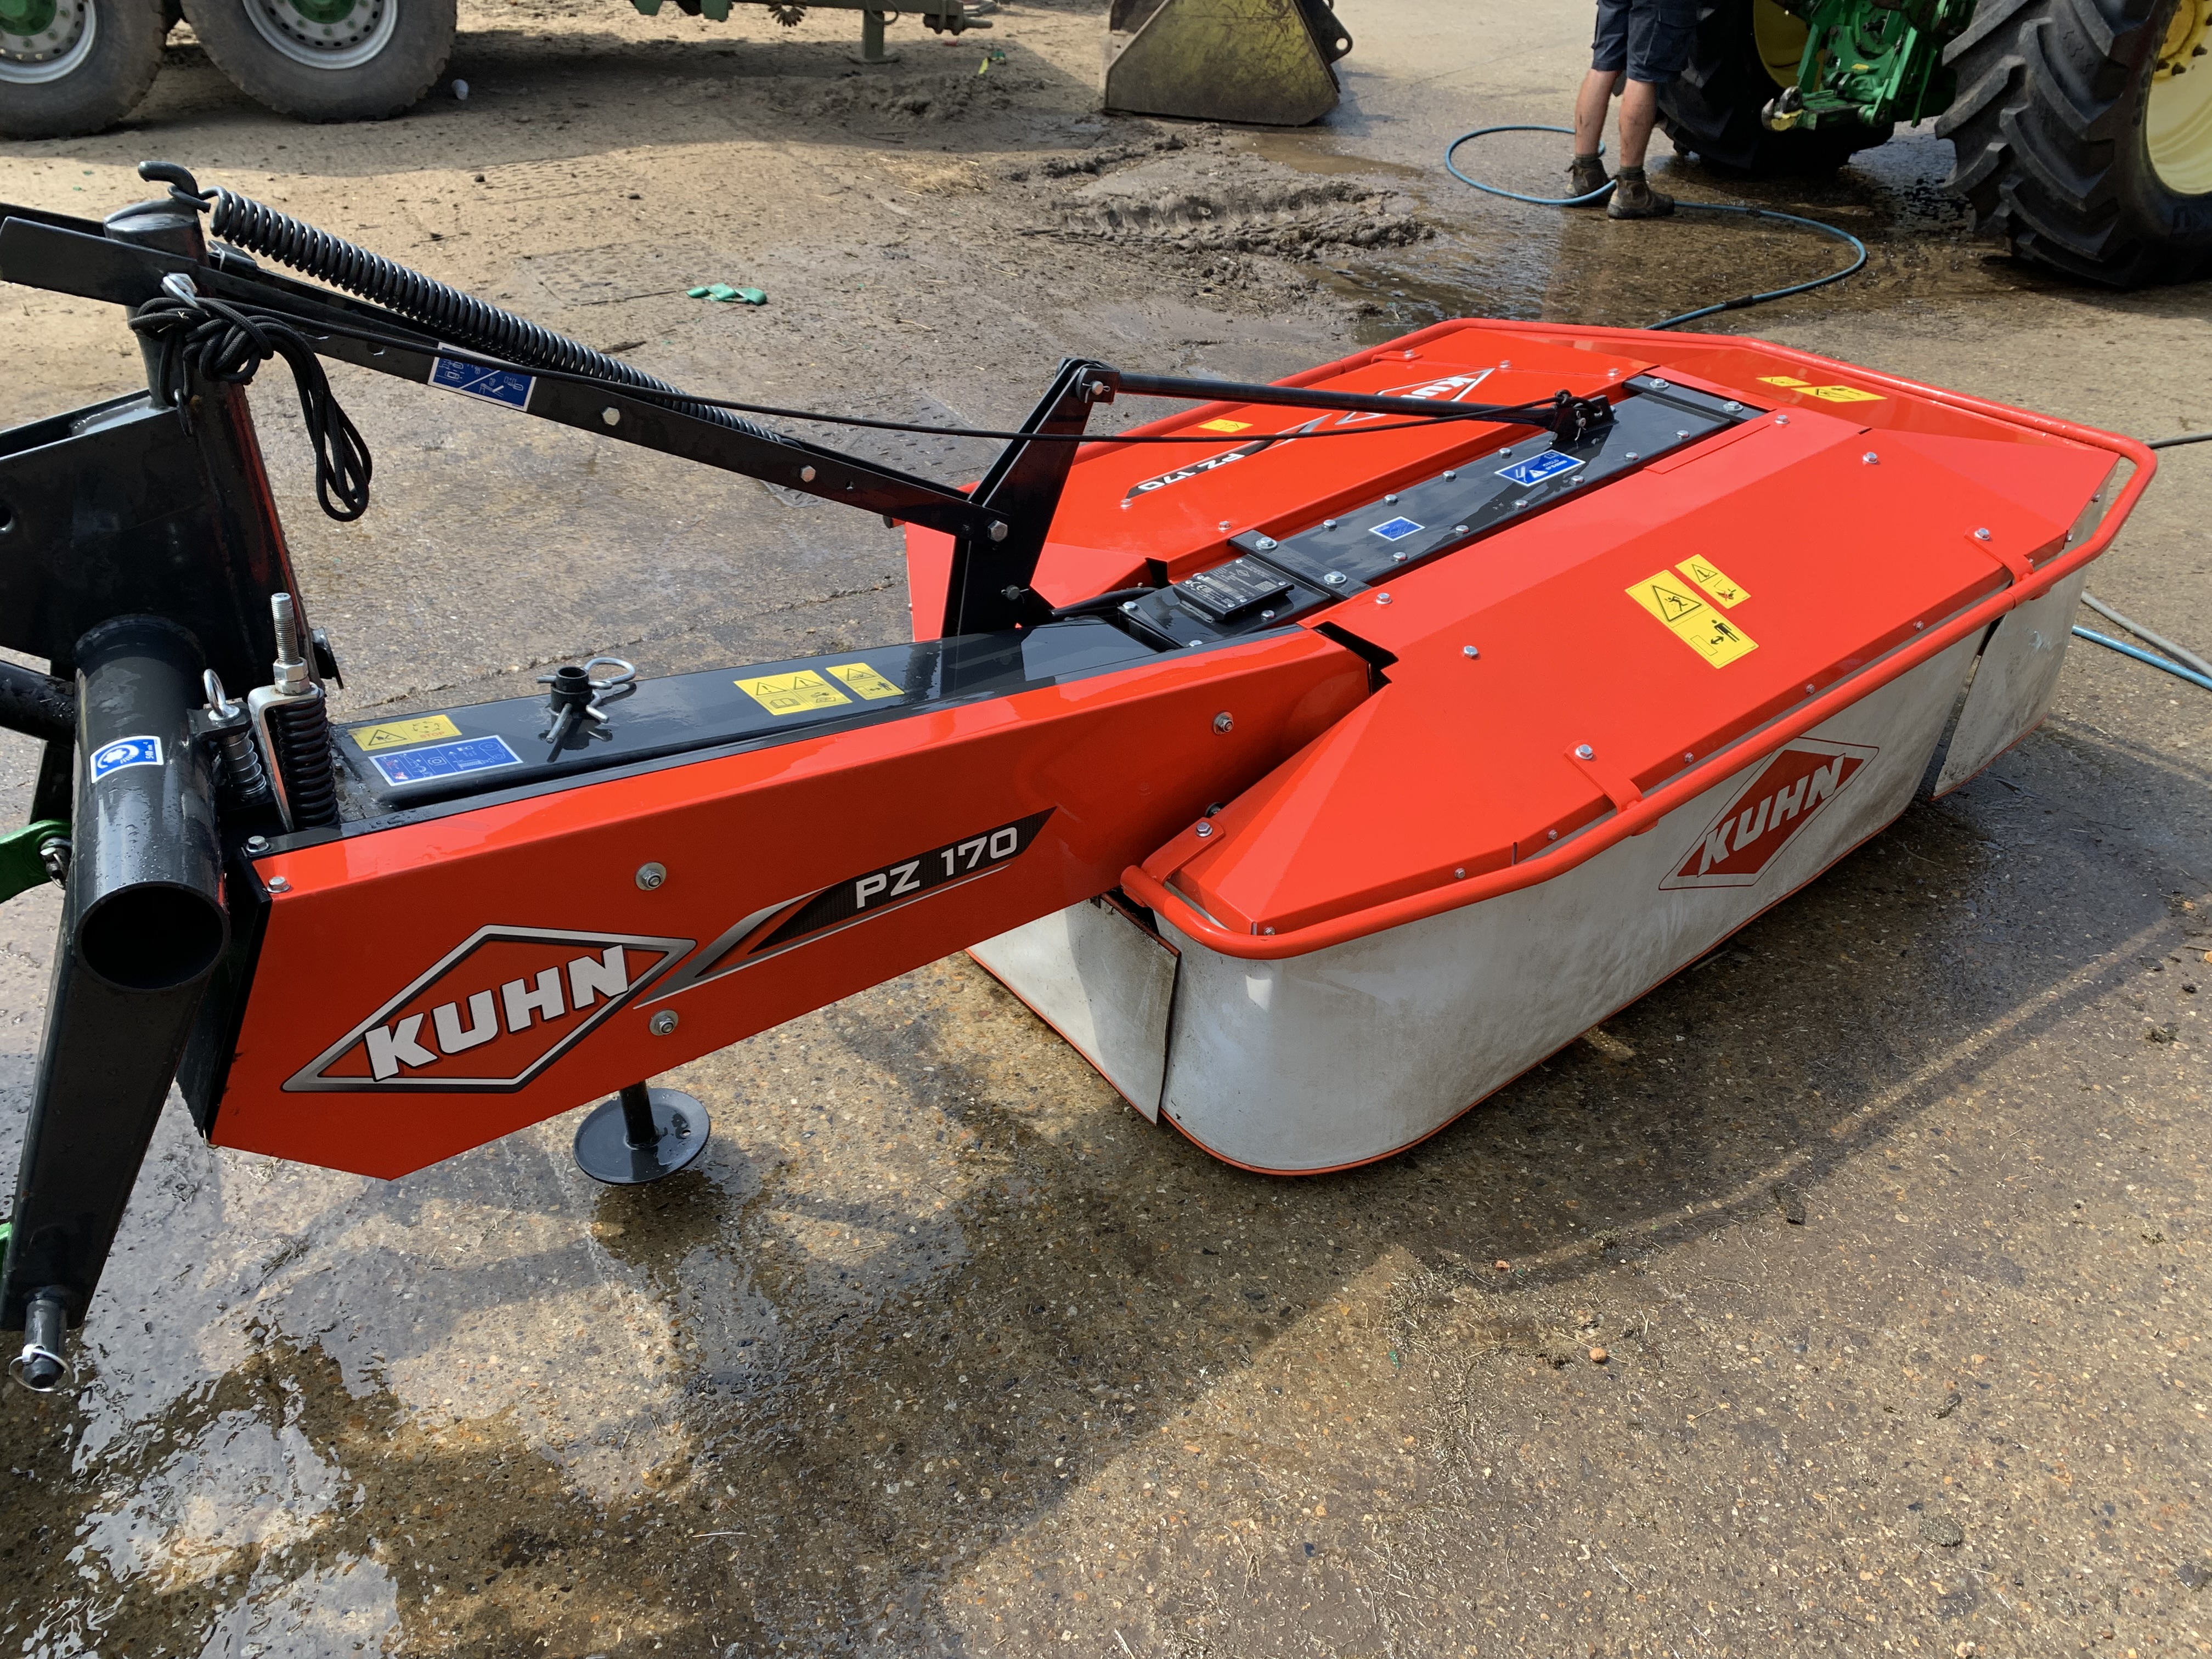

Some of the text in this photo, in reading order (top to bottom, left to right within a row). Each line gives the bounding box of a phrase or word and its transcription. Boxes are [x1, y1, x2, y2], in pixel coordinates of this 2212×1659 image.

[1400, 376, 1476, 399] KU
[1138, 453, 1245, 490] PZ 170
[1697, 753, 1846, 878] KUHN
[855, 827, 1017, 909] PZ 170
[363, 944, 630, 1082] KUHN
